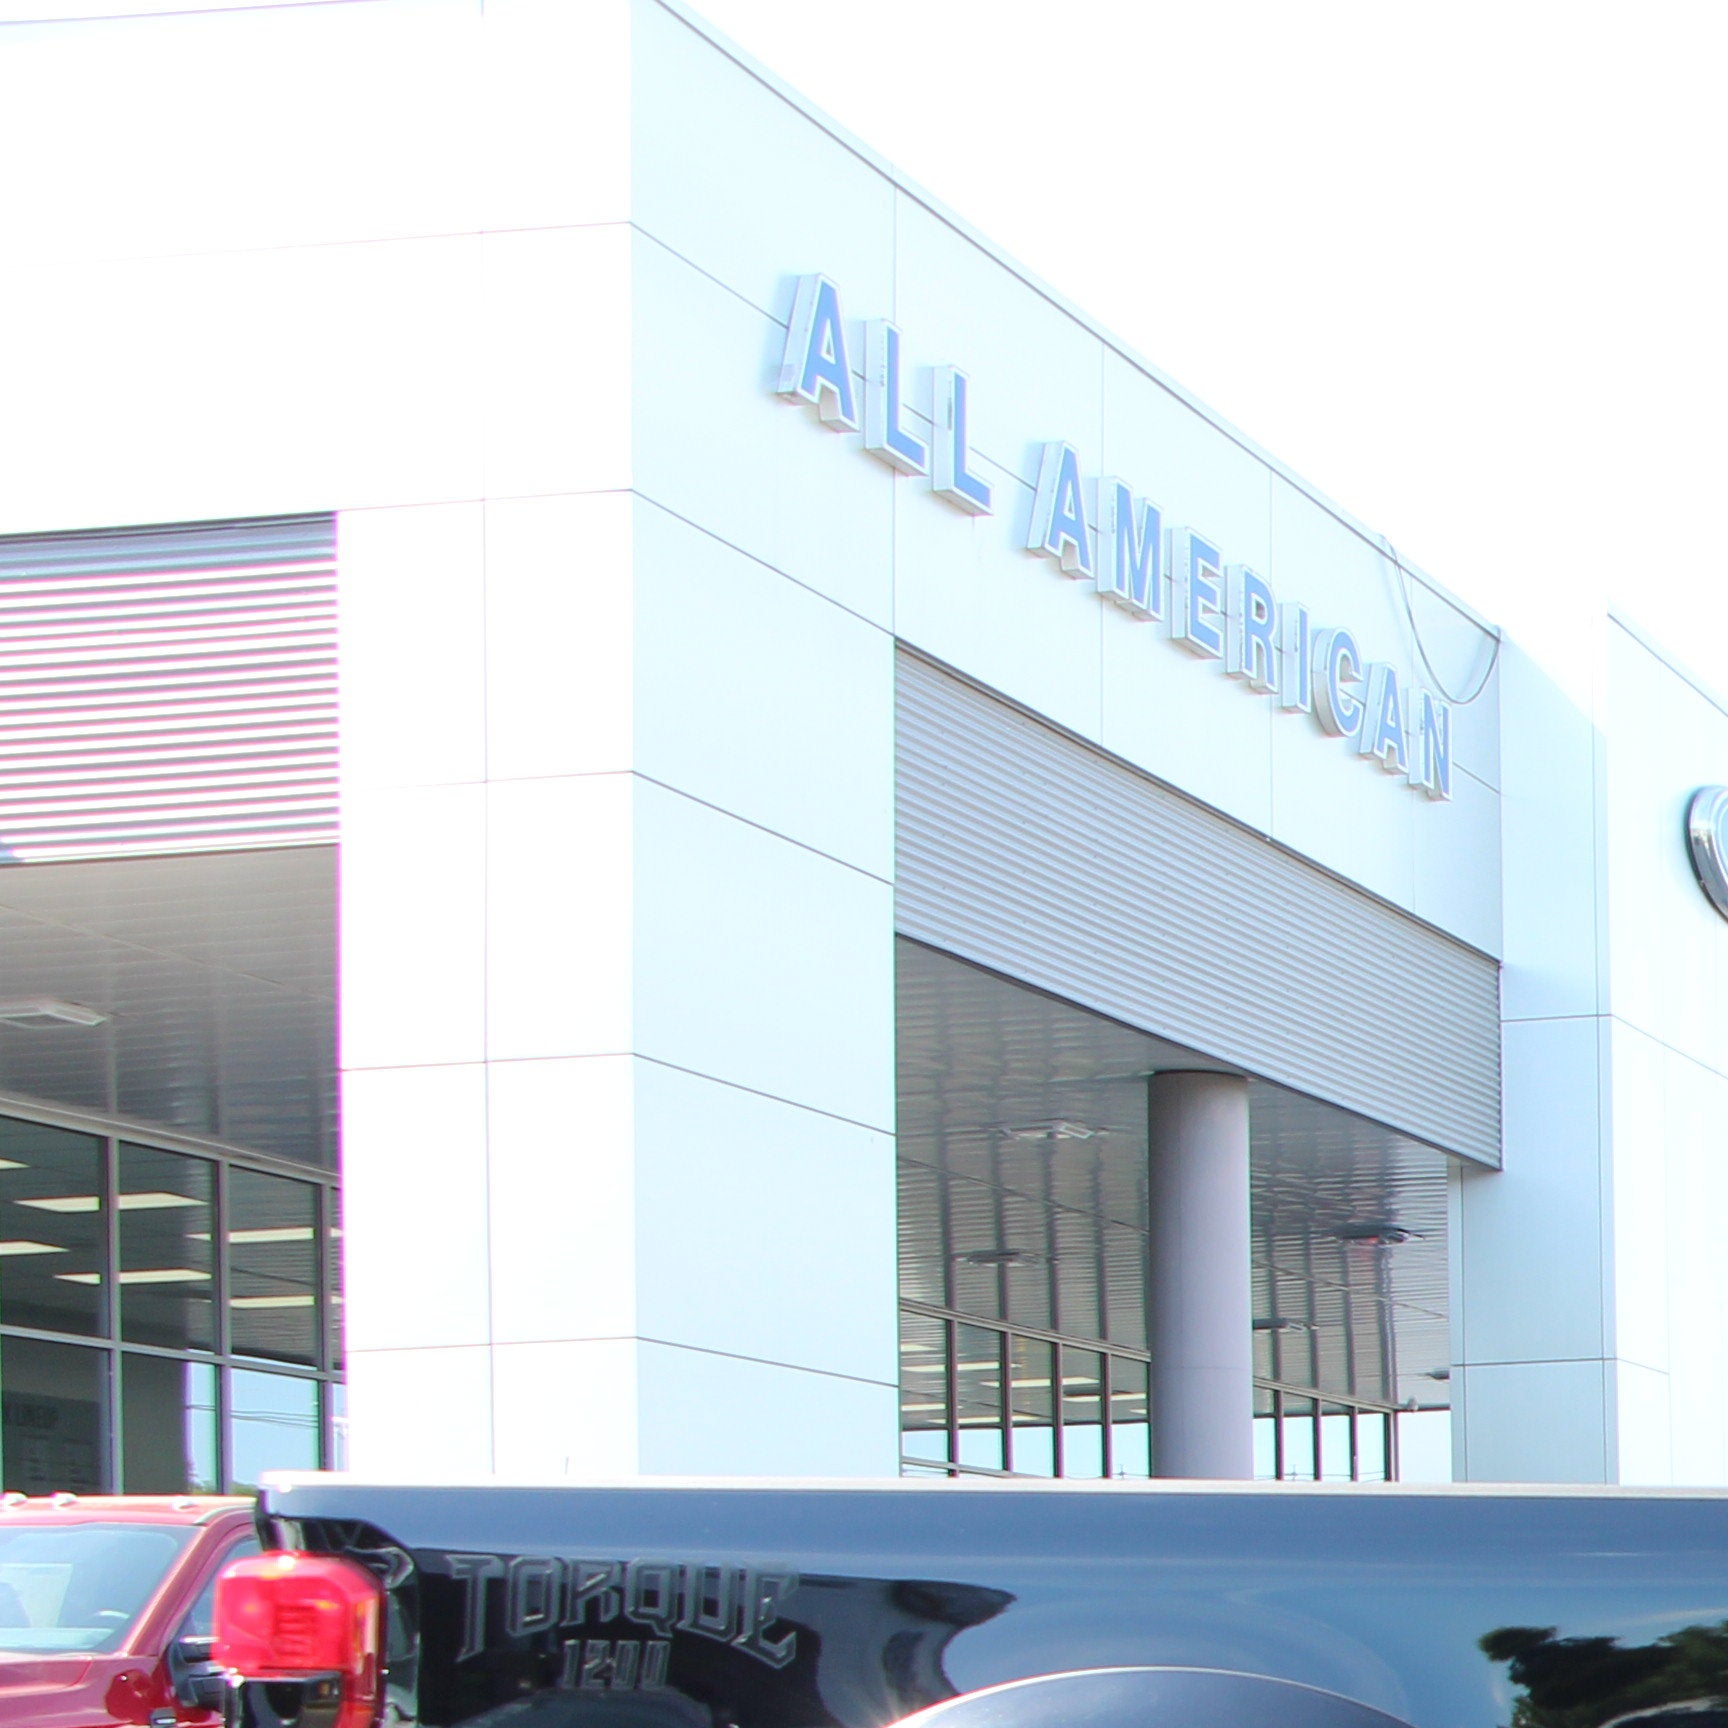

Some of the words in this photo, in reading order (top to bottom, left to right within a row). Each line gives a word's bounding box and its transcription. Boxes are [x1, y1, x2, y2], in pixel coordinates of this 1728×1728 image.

[775, 272, 995, 515] ALL
[1024, 438, 1454, 801] AMERICAN
[446, 1553, 798, 1670] TORQUE
